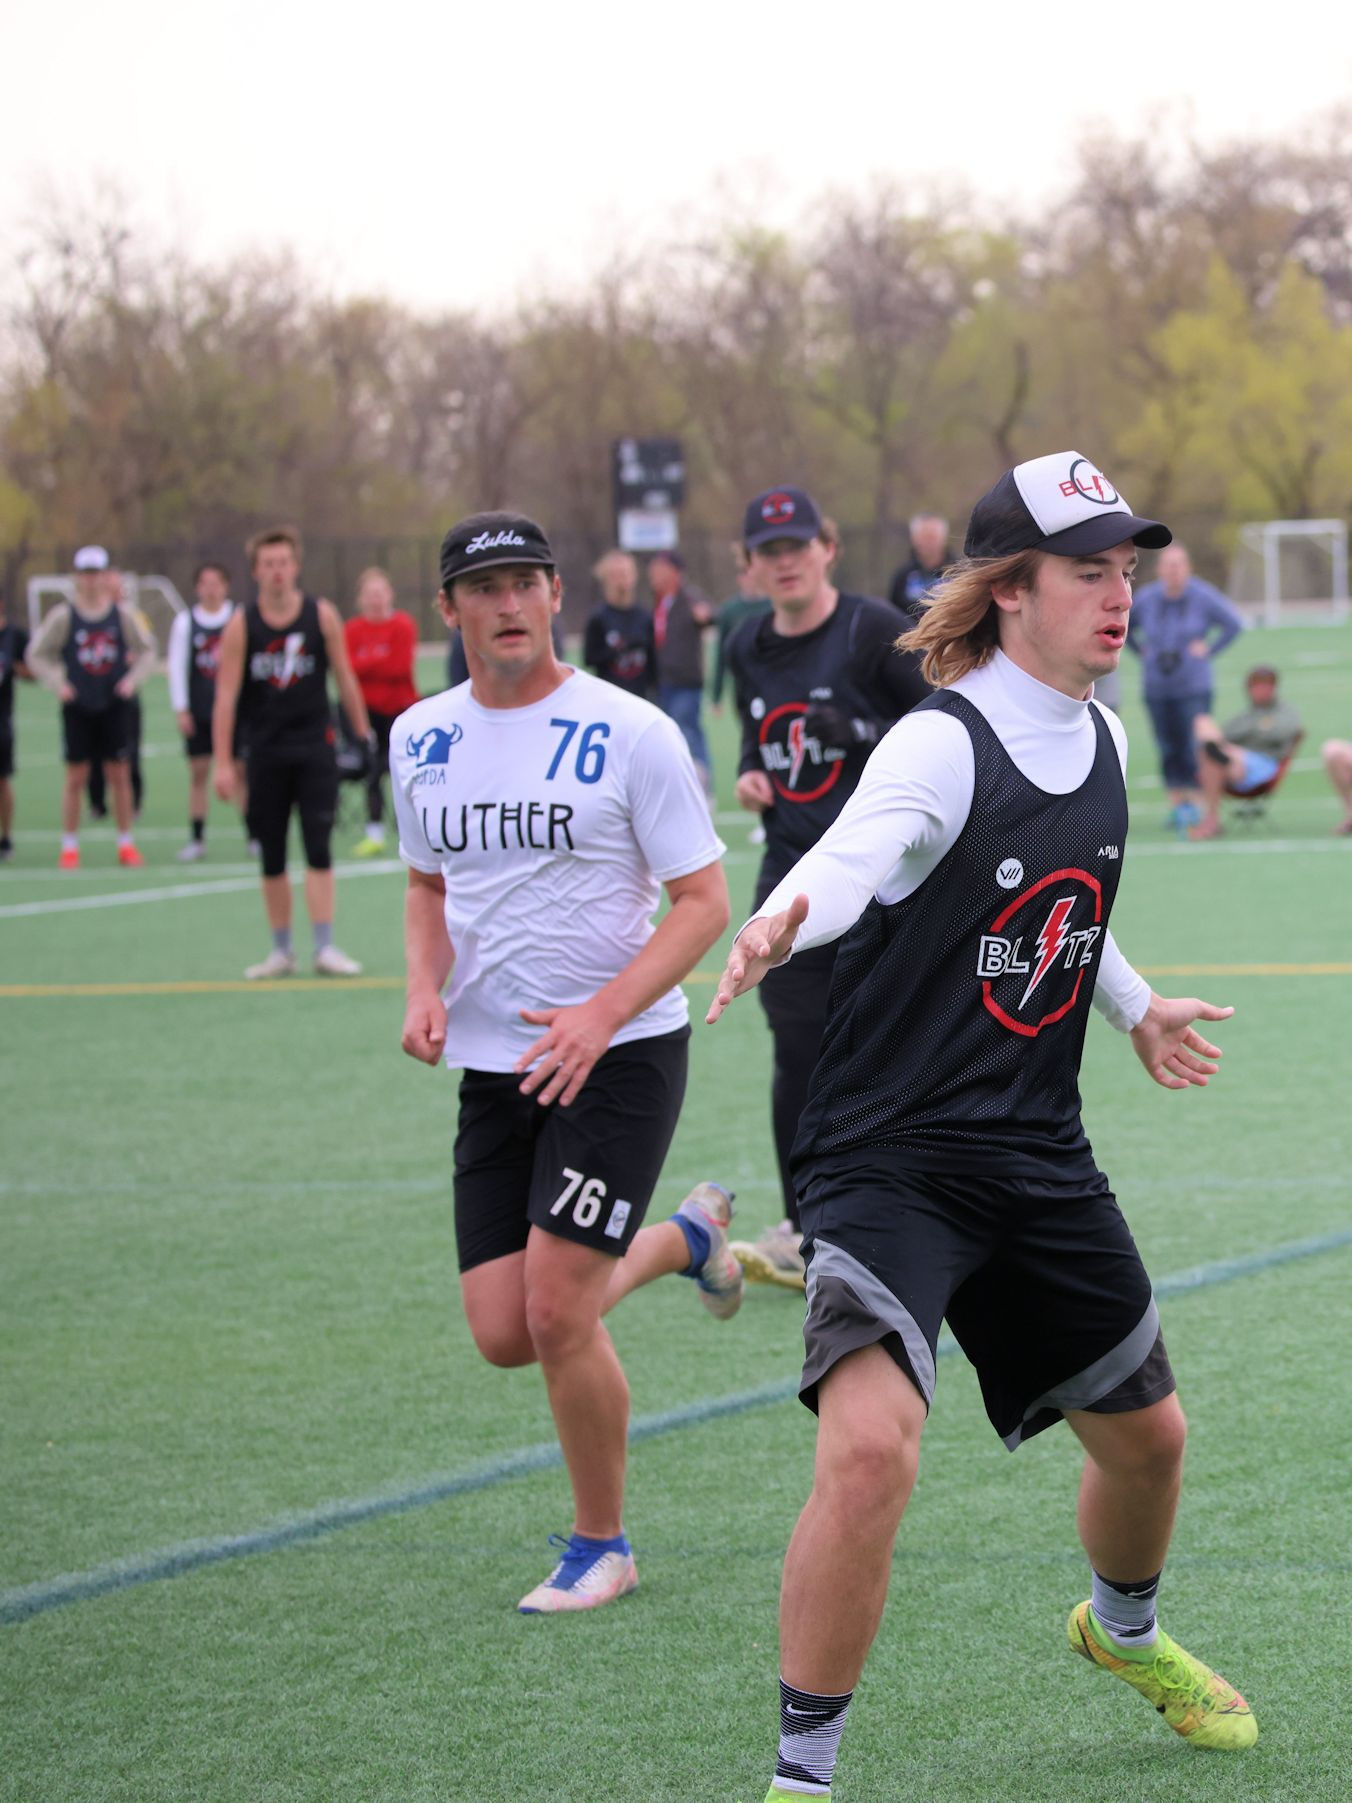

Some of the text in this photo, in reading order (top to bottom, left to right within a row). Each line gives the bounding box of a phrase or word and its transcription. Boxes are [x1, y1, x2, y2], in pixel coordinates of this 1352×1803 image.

[545, 718, 611, 785] 76
[423, 801, 575, 853] LUTHER
[550, 1167, 607, 1228] 76
